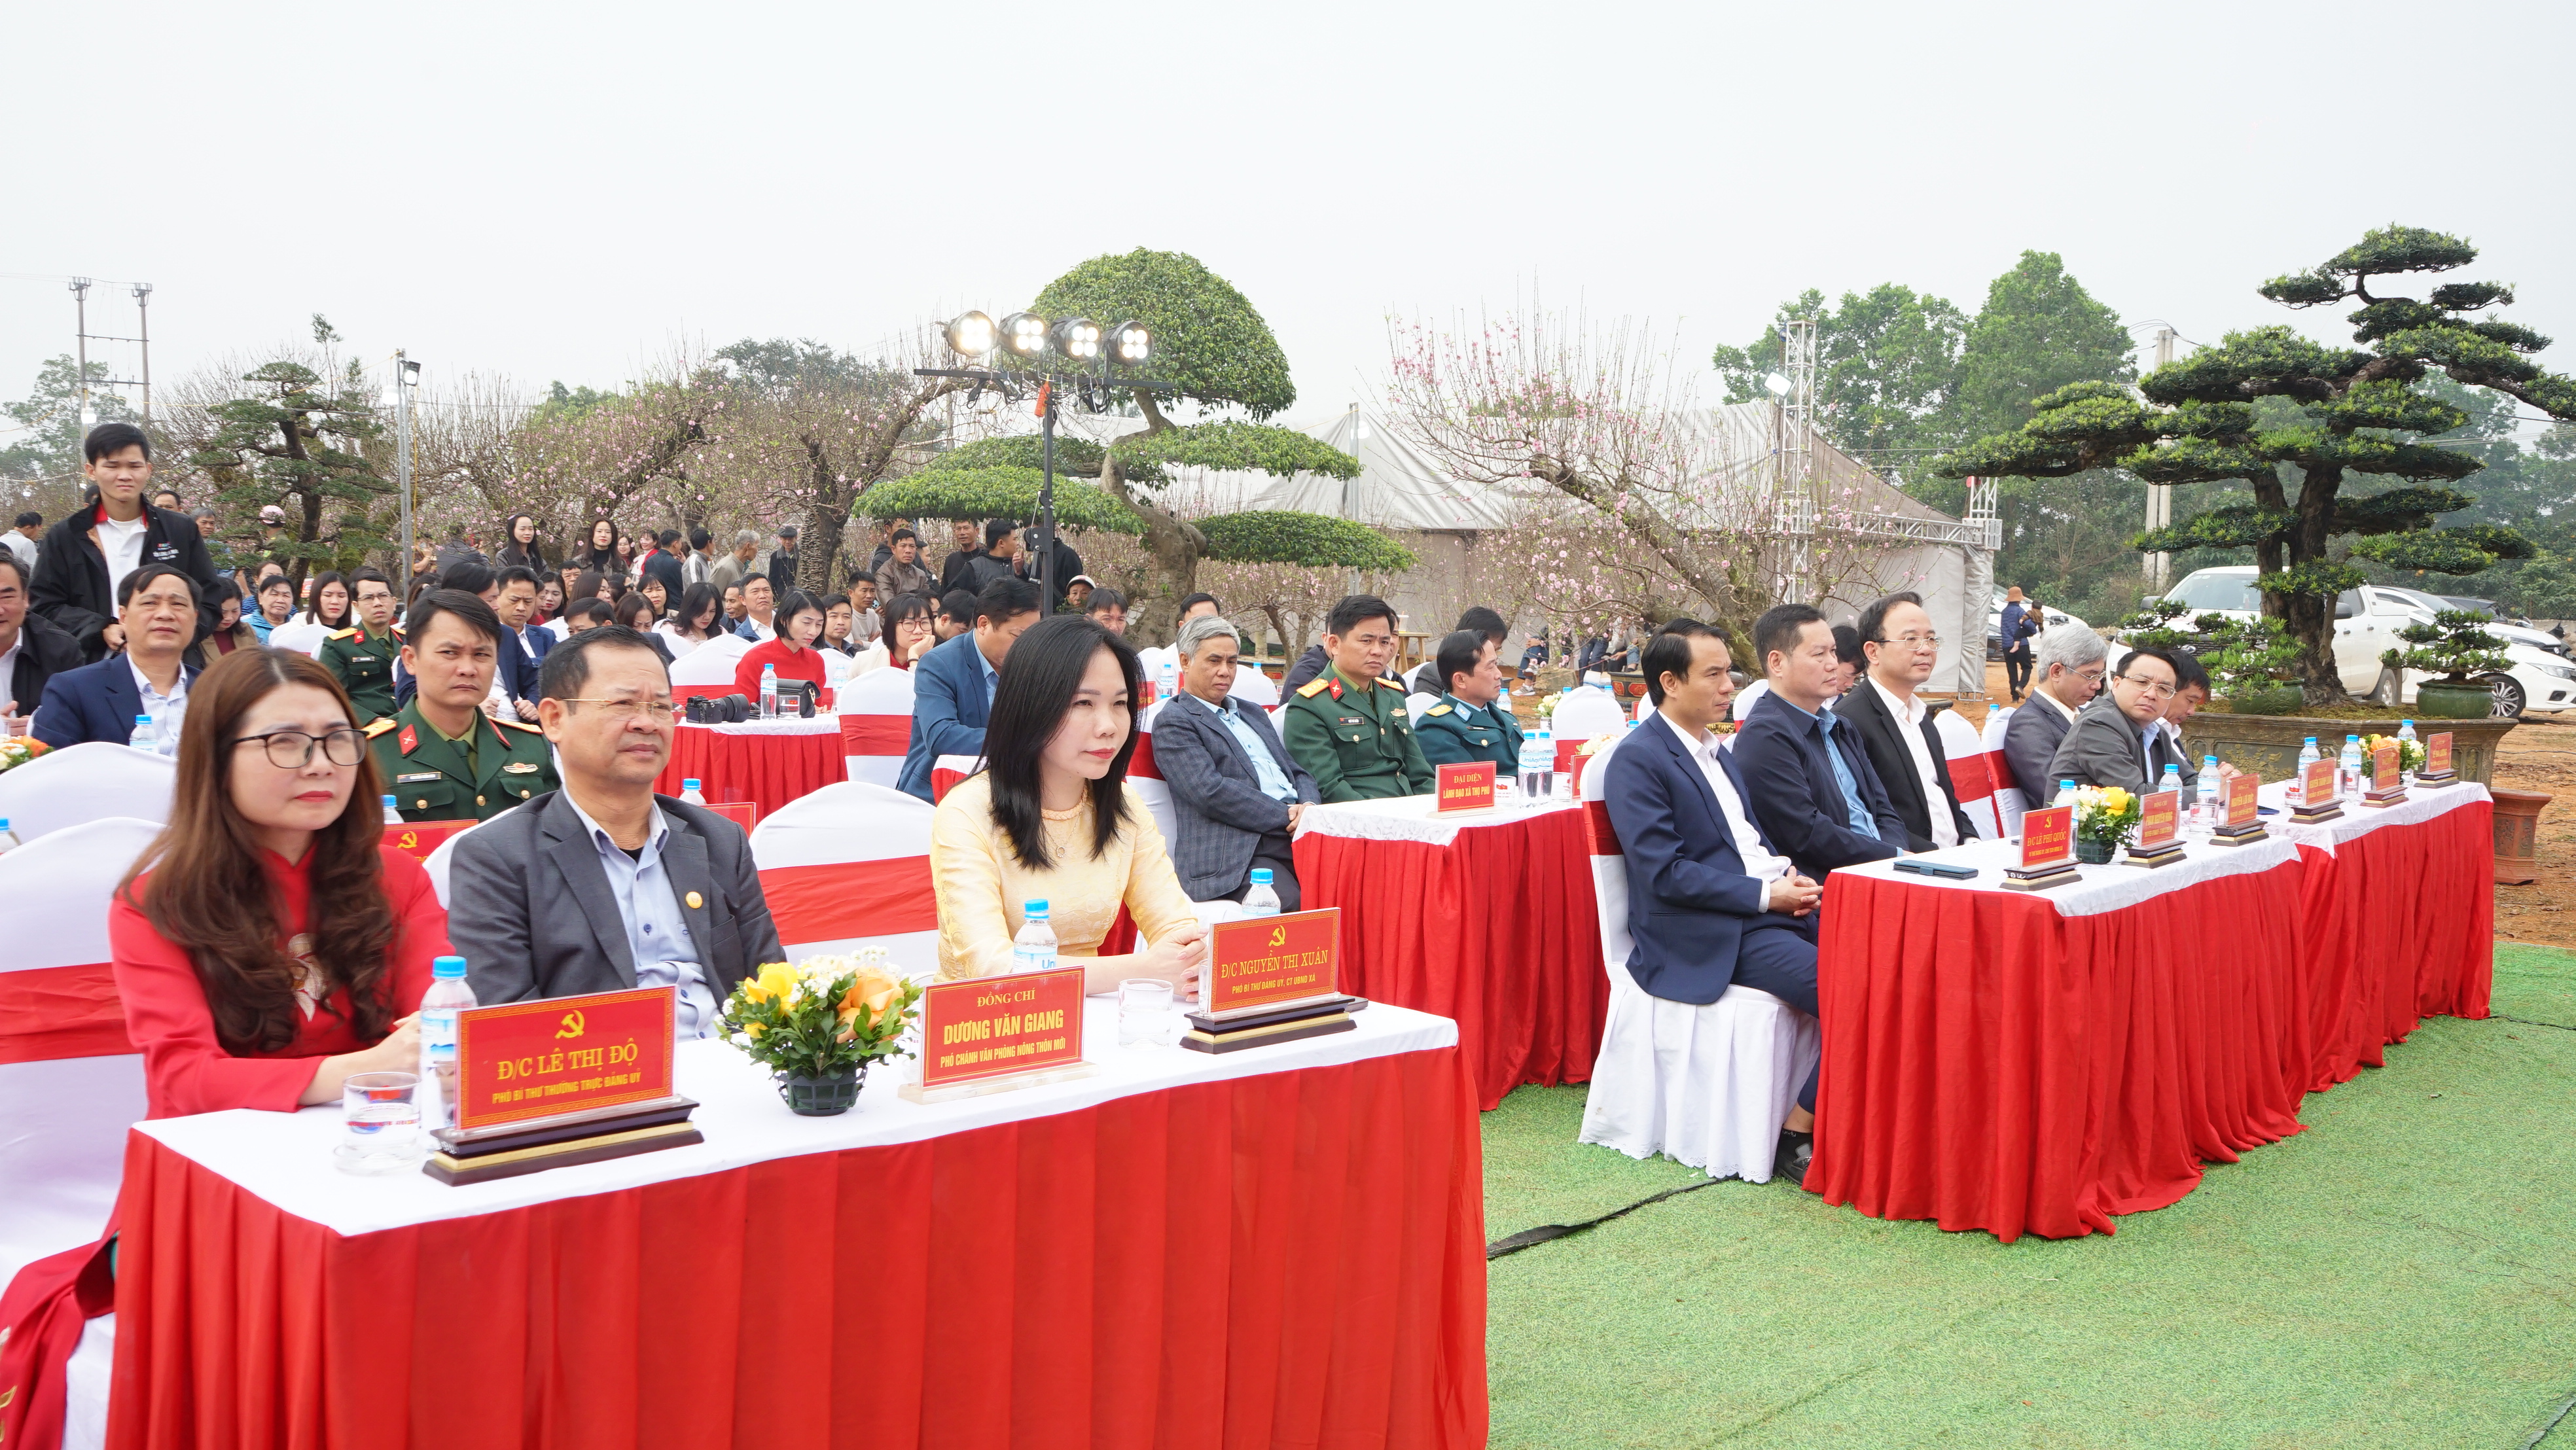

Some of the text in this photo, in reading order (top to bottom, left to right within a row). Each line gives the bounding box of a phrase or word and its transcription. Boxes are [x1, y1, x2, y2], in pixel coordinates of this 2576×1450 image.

[1454, 772, 1482, 785] ĐẠI DIỆN
[1443, 788, 1455, 799] LÃNH
[1455, 788, 1465, 799] ĐẠO
[1465, 786, 1471, 797] XÃ
[2053, 827, 2067, 842] QUỐC
[1221, 946, 1329, 979] Đ/C NGUYỄN THỊ XUÂN
[976, 987, 1035, 1007] ĐỒNG CHÍ
[1232, 984, 1243, 995] PHÓ
[1243, 983, 1249, 993] BÍ
[1251, 981, 1262, 991] THƯ
[1261, 977, 1276, 990] ĐẢNG
[1286, 977, 1293, 985] CT
[1293, 975, 1308, 985] UBND
[1308, 972, 1316, 982] XÃ
[944, 1009, 1064, 1045] DƯƠNG VĂN GIANG
[497, 1037, 639, 1080] Đ/C LÊ THỊ ĐỘ
[940, 1036, 1066, 1068] PHÓ CHÁNH VĂN PHÒNG NÔNG THÔN MỚI
[492, 1089, 512, 1104] PHÓ
[512, 1087, 524, 1101] BÍ
[524, 1086, 544, 1099] THƯ
[544, 1080, 580, 1097] THƯỜNG
[580, 1077, 603, 1092] TRỰC
[603, 1071, 629, 1087] ĐẢNG
